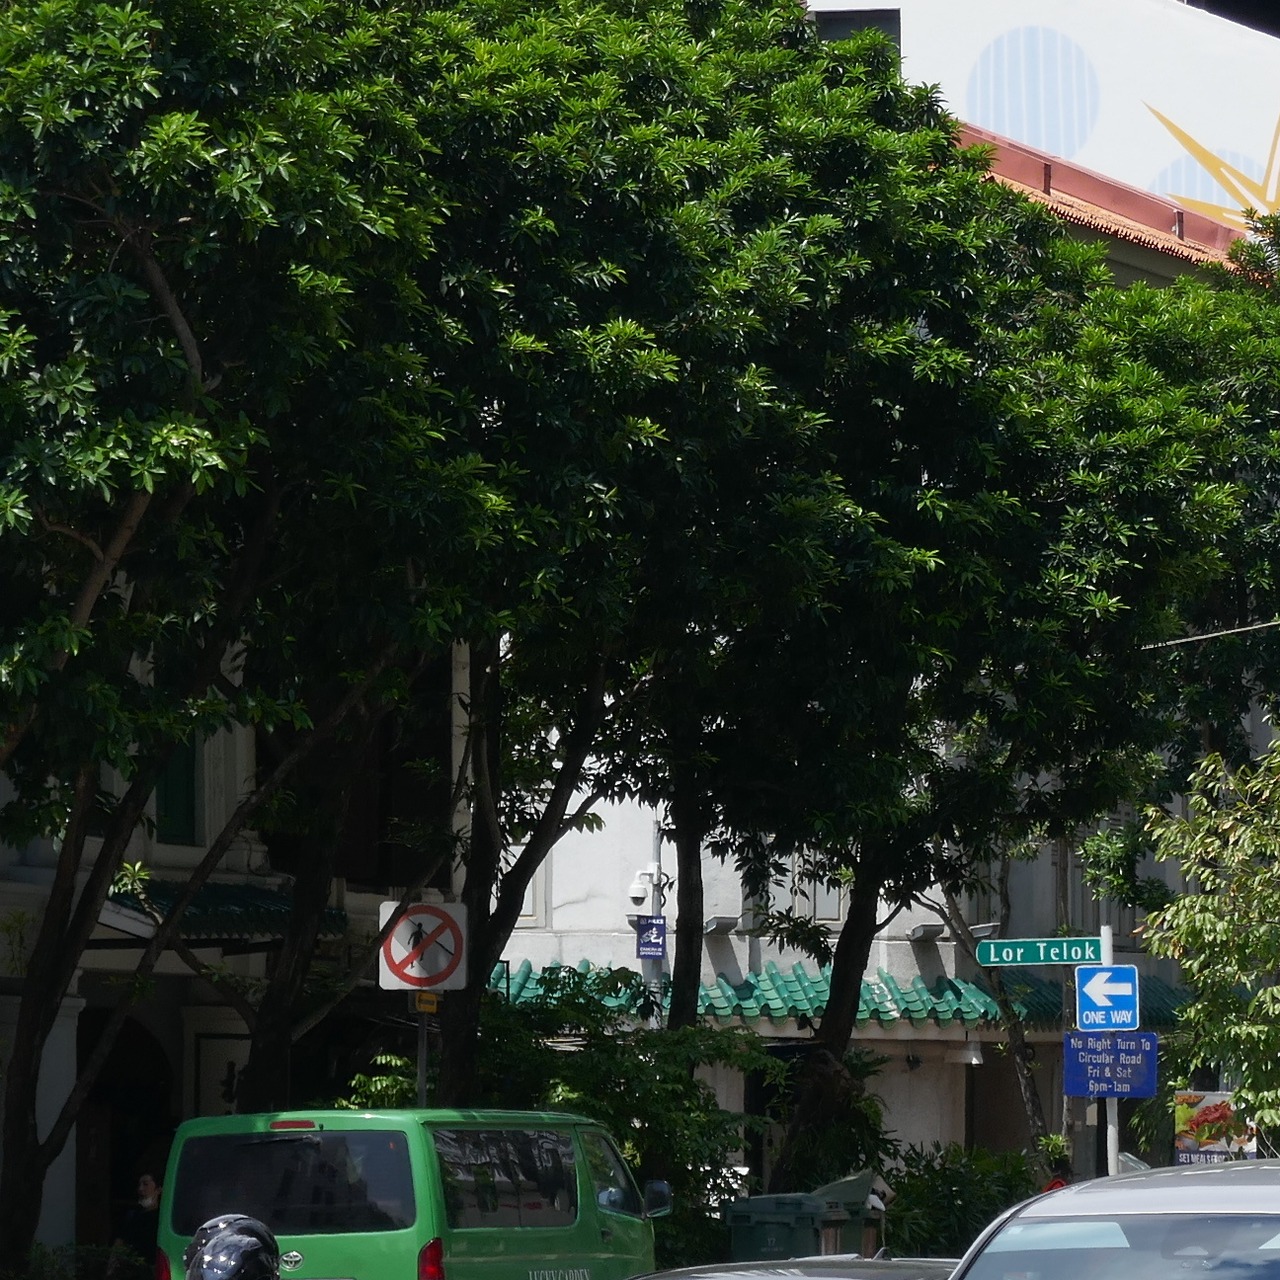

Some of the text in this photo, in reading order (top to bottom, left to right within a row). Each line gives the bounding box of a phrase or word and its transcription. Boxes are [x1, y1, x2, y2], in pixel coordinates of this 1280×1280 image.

[990, 942, 1096, 962] Lor Telok
[1083, 1010, 1133, 1025] ONE WAY
[1070, 1037, 1151, 1052] No Right Turn To
[1078, 1053, 1142, 1064] Circular Road
[1087, 1066, 1132, 1078] Fri & Sat
[1088, 1080, 1131, 1095] 6pm-1am
